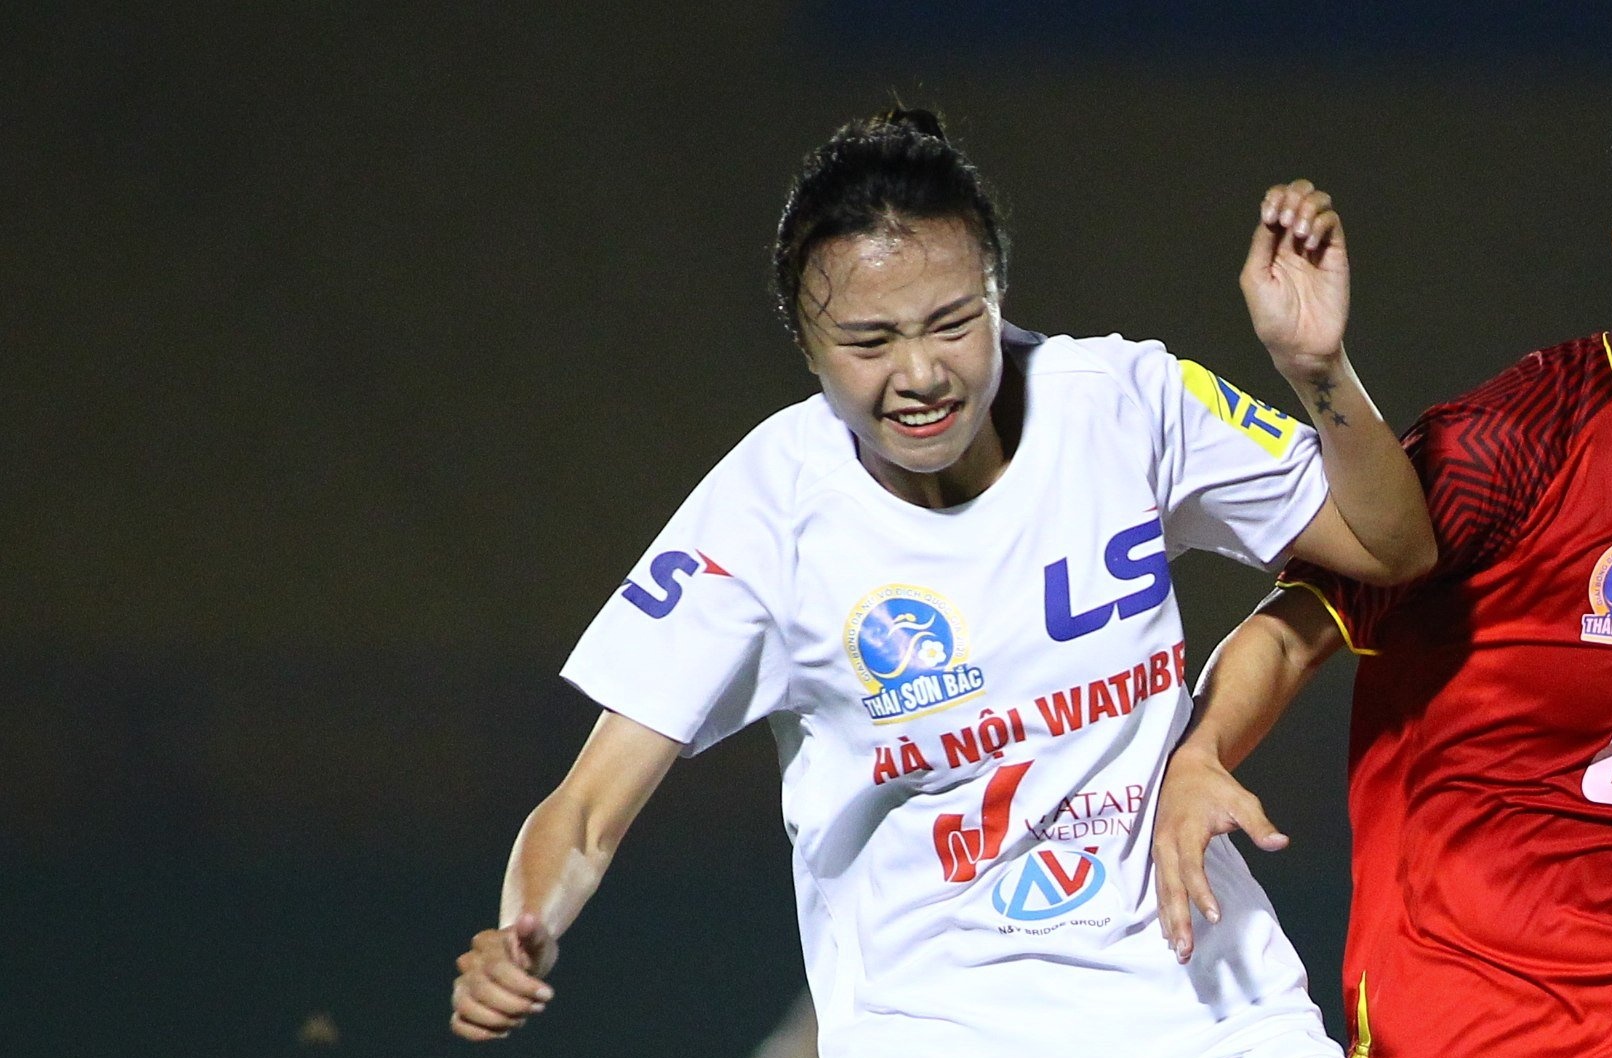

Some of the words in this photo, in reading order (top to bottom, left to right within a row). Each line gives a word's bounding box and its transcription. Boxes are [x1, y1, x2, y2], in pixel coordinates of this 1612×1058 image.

[621, 550, 700, 619] S
[1044, 516, 1172, 642] LS
[864, 688, 902, 718] THÁI
[900, 675, 943, 711] SƠN
[942, 665, 983, 698] BẮC
[873, 736, 934, 785] HÀ
[940, 707, 1027, 770] NỘI
